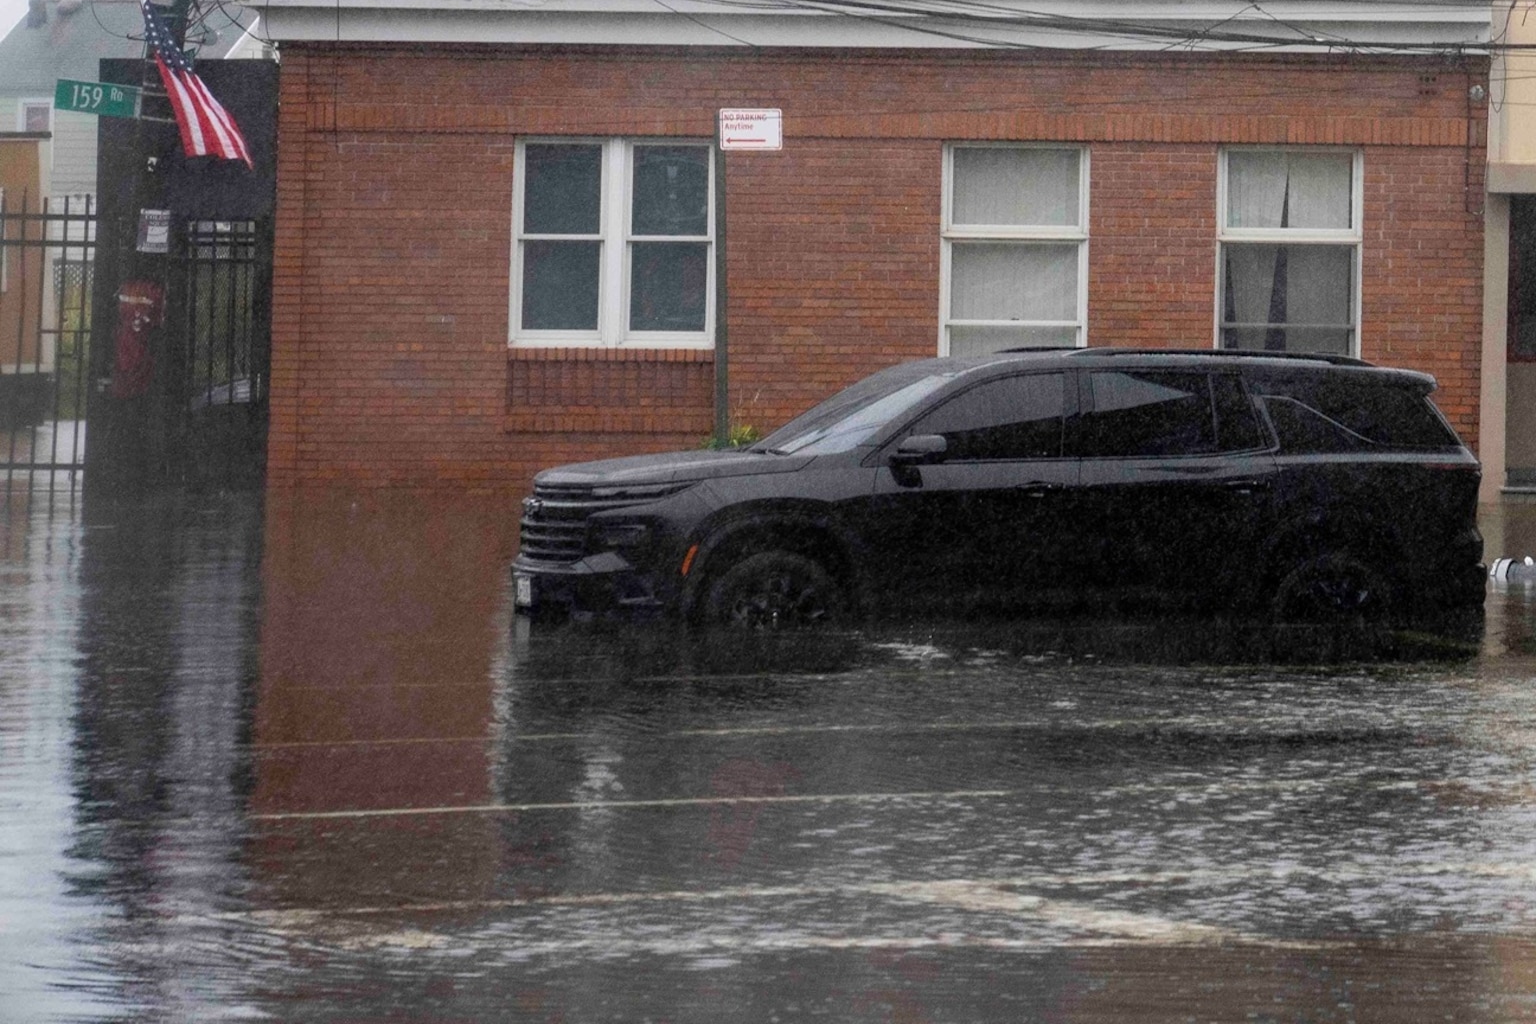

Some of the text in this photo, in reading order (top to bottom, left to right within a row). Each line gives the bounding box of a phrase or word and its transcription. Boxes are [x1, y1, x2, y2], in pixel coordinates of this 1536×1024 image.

[72, 84, 103, 108] 159
[723, 113, 767, 121] NO PARKING
[725, 122, 753, 131] Anytime
